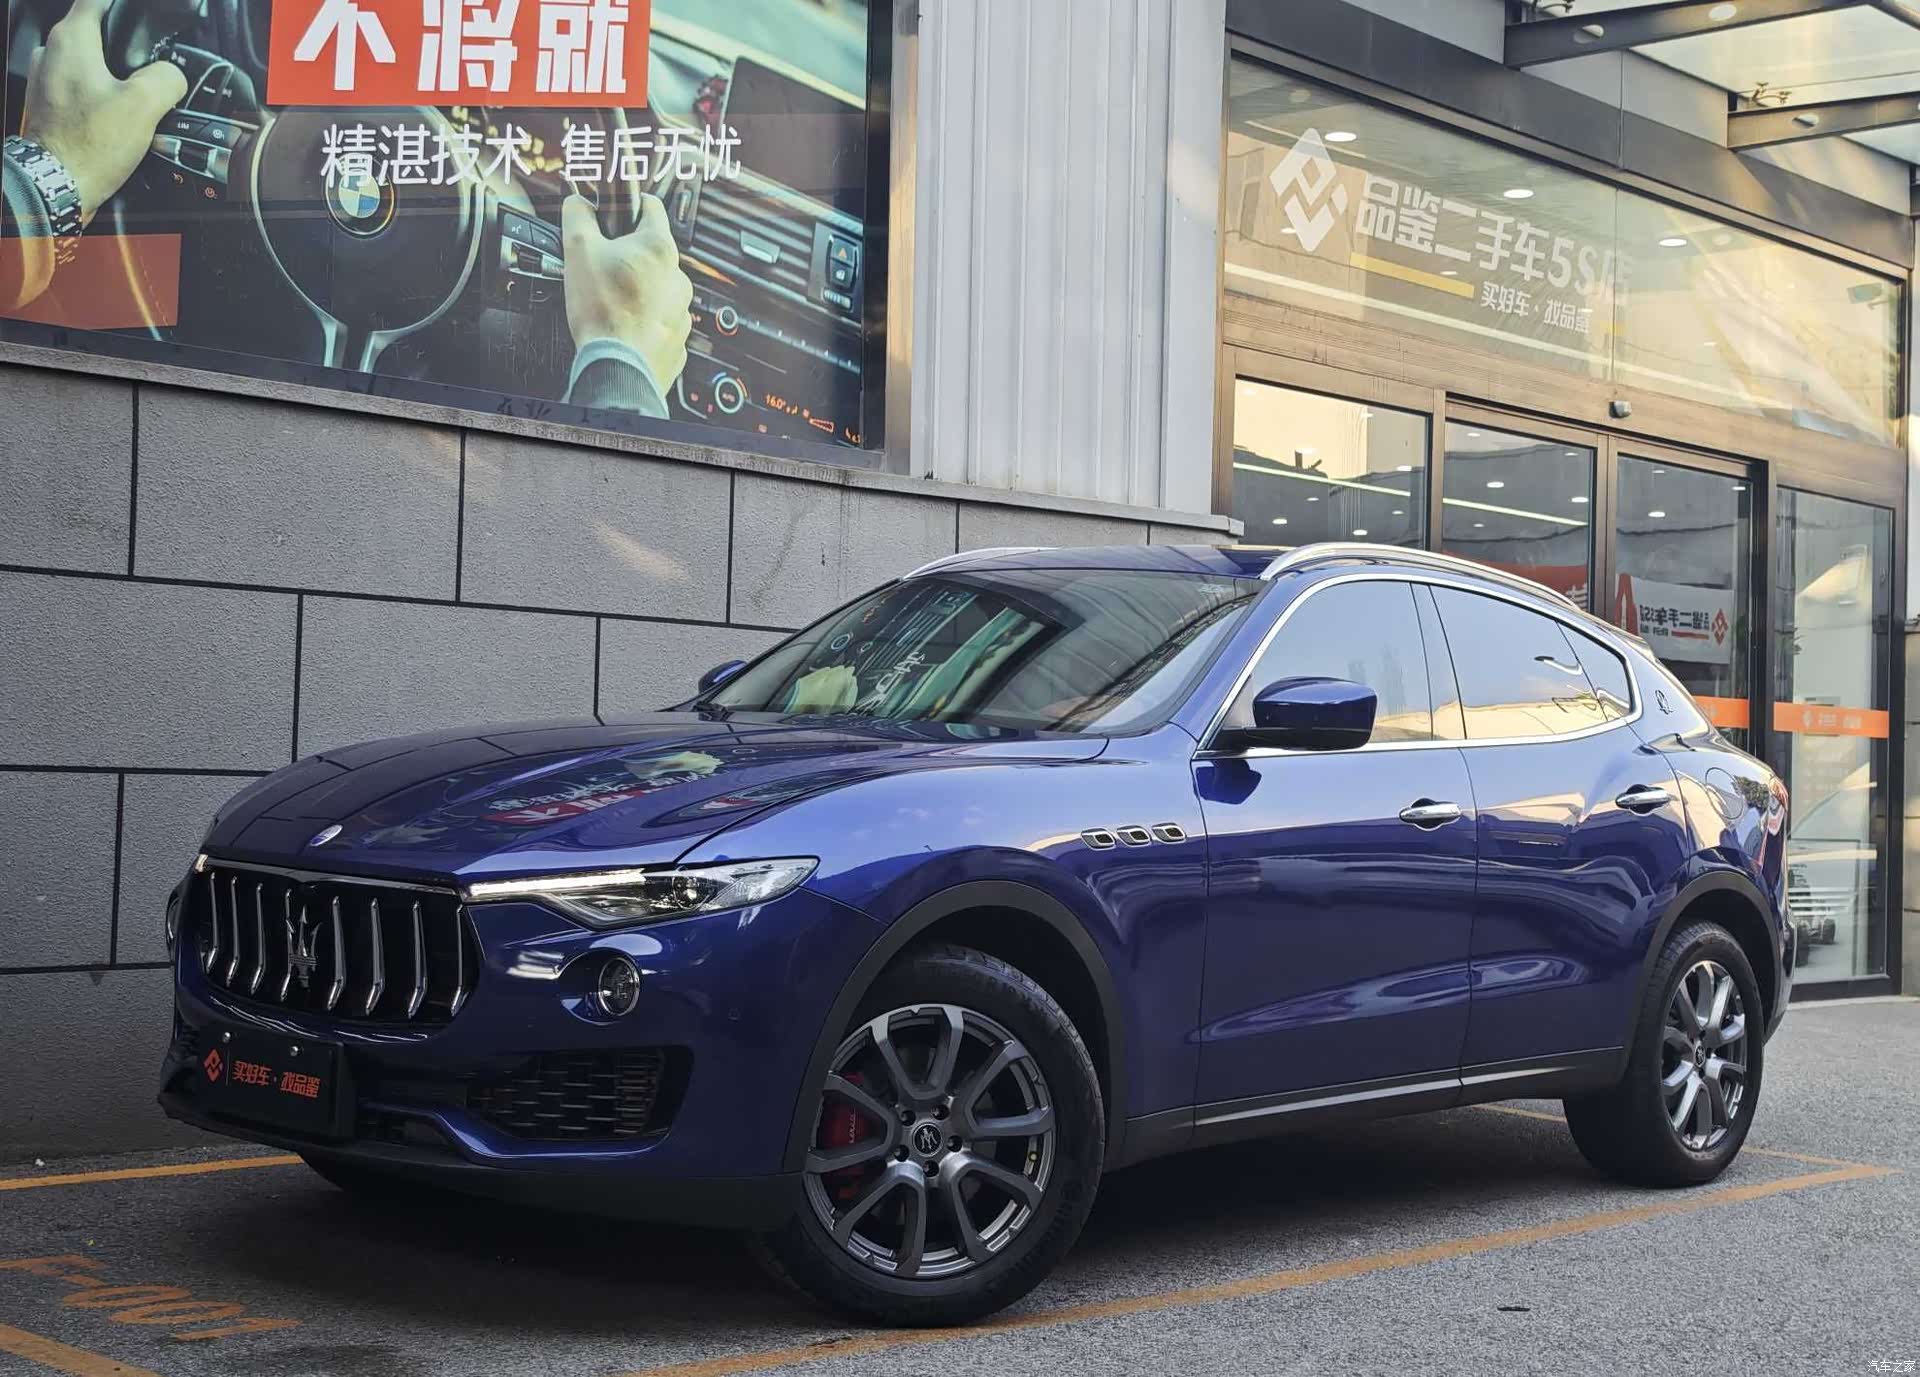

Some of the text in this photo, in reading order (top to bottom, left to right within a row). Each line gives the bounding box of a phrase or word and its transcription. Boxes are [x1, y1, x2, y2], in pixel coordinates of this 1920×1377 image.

[294, 0, 628, 94] 不将就
[320, 123, 741, 188] 精湛技术 售后无忧
